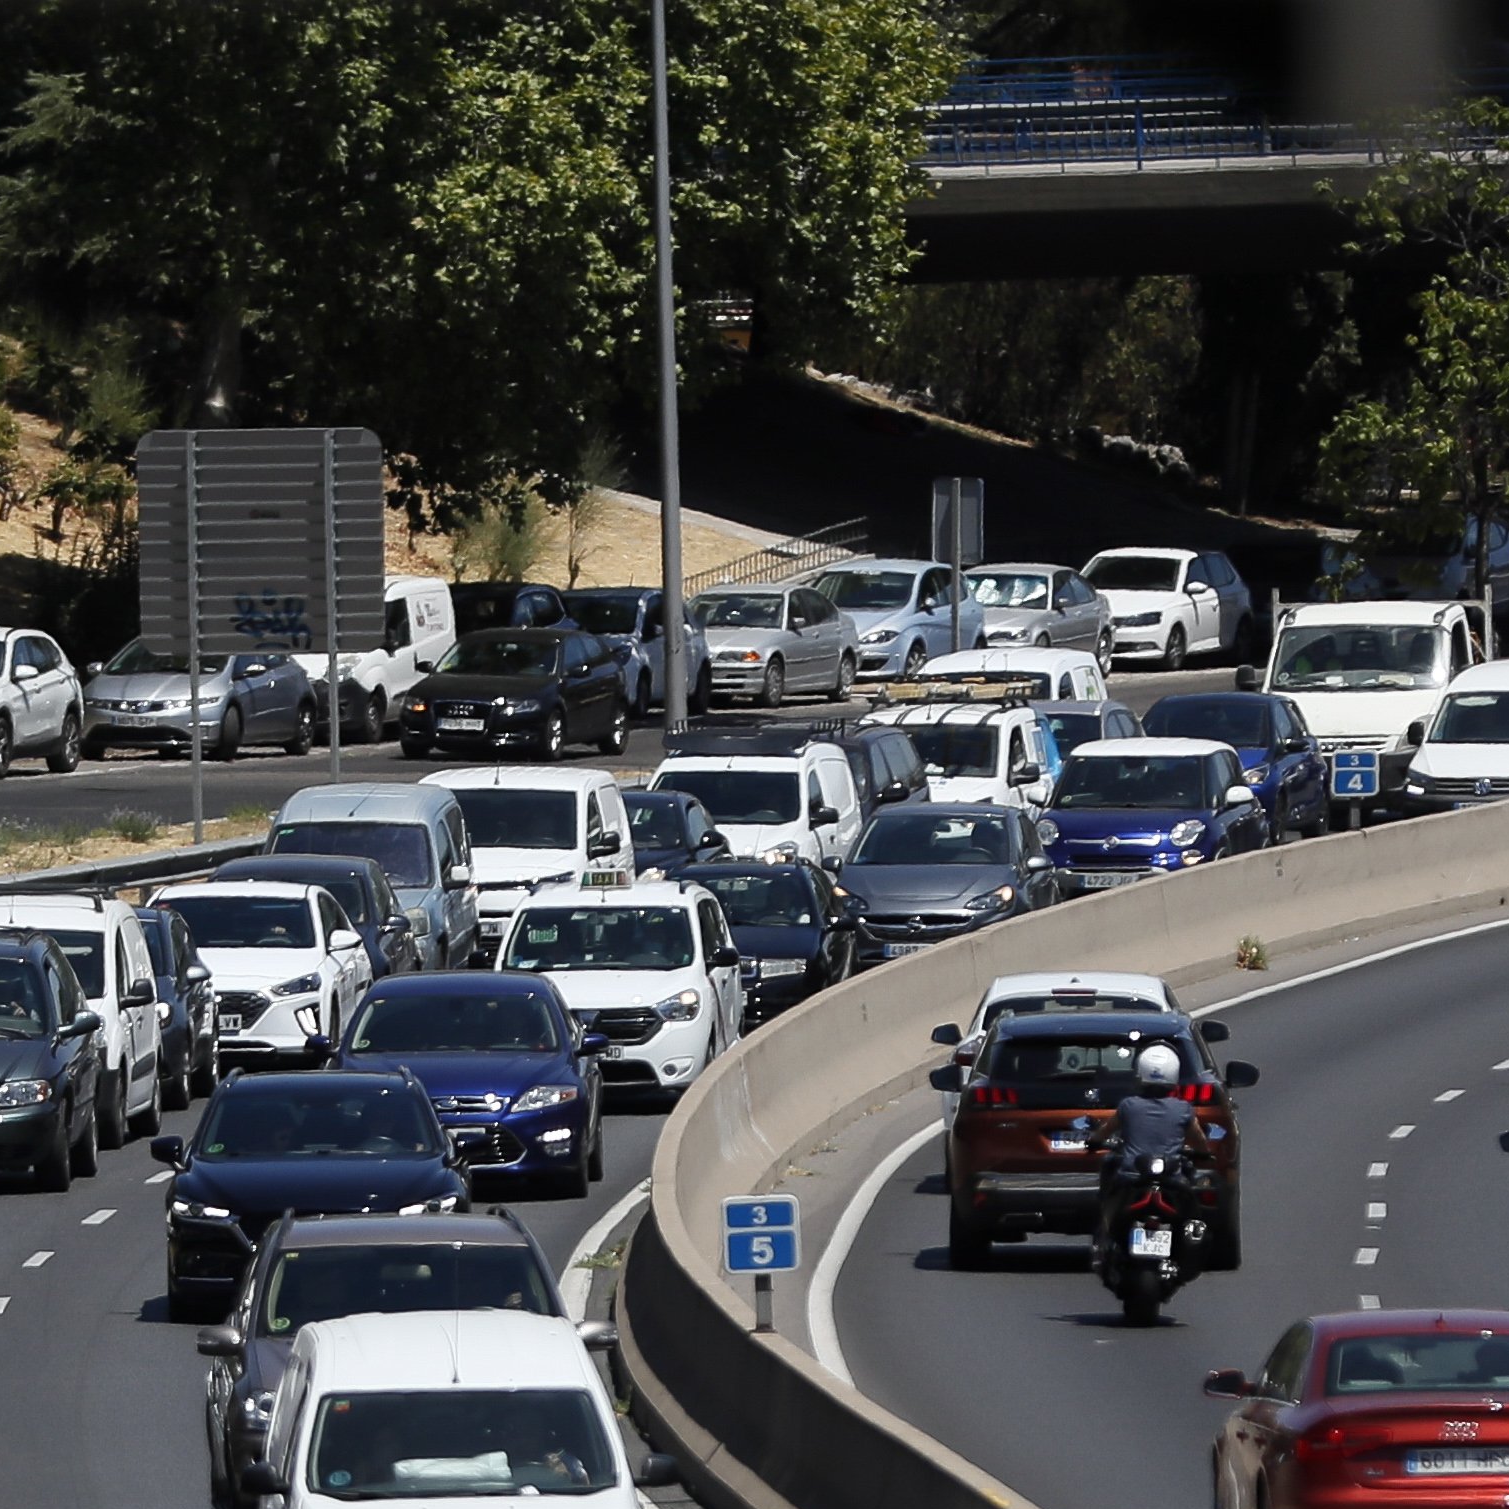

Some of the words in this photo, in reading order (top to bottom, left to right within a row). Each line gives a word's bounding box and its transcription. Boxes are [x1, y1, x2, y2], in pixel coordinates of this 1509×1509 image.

[1350, 755, 1359, 766] 3
[1348, 773, 1363, 790] 4
[593, 873, 614, 885] TAXI
[753, 1206, 767, 1224] 3
[752, 1236, 774, 1264] 5
[1421, 1451, 1468, 1470] 6011
